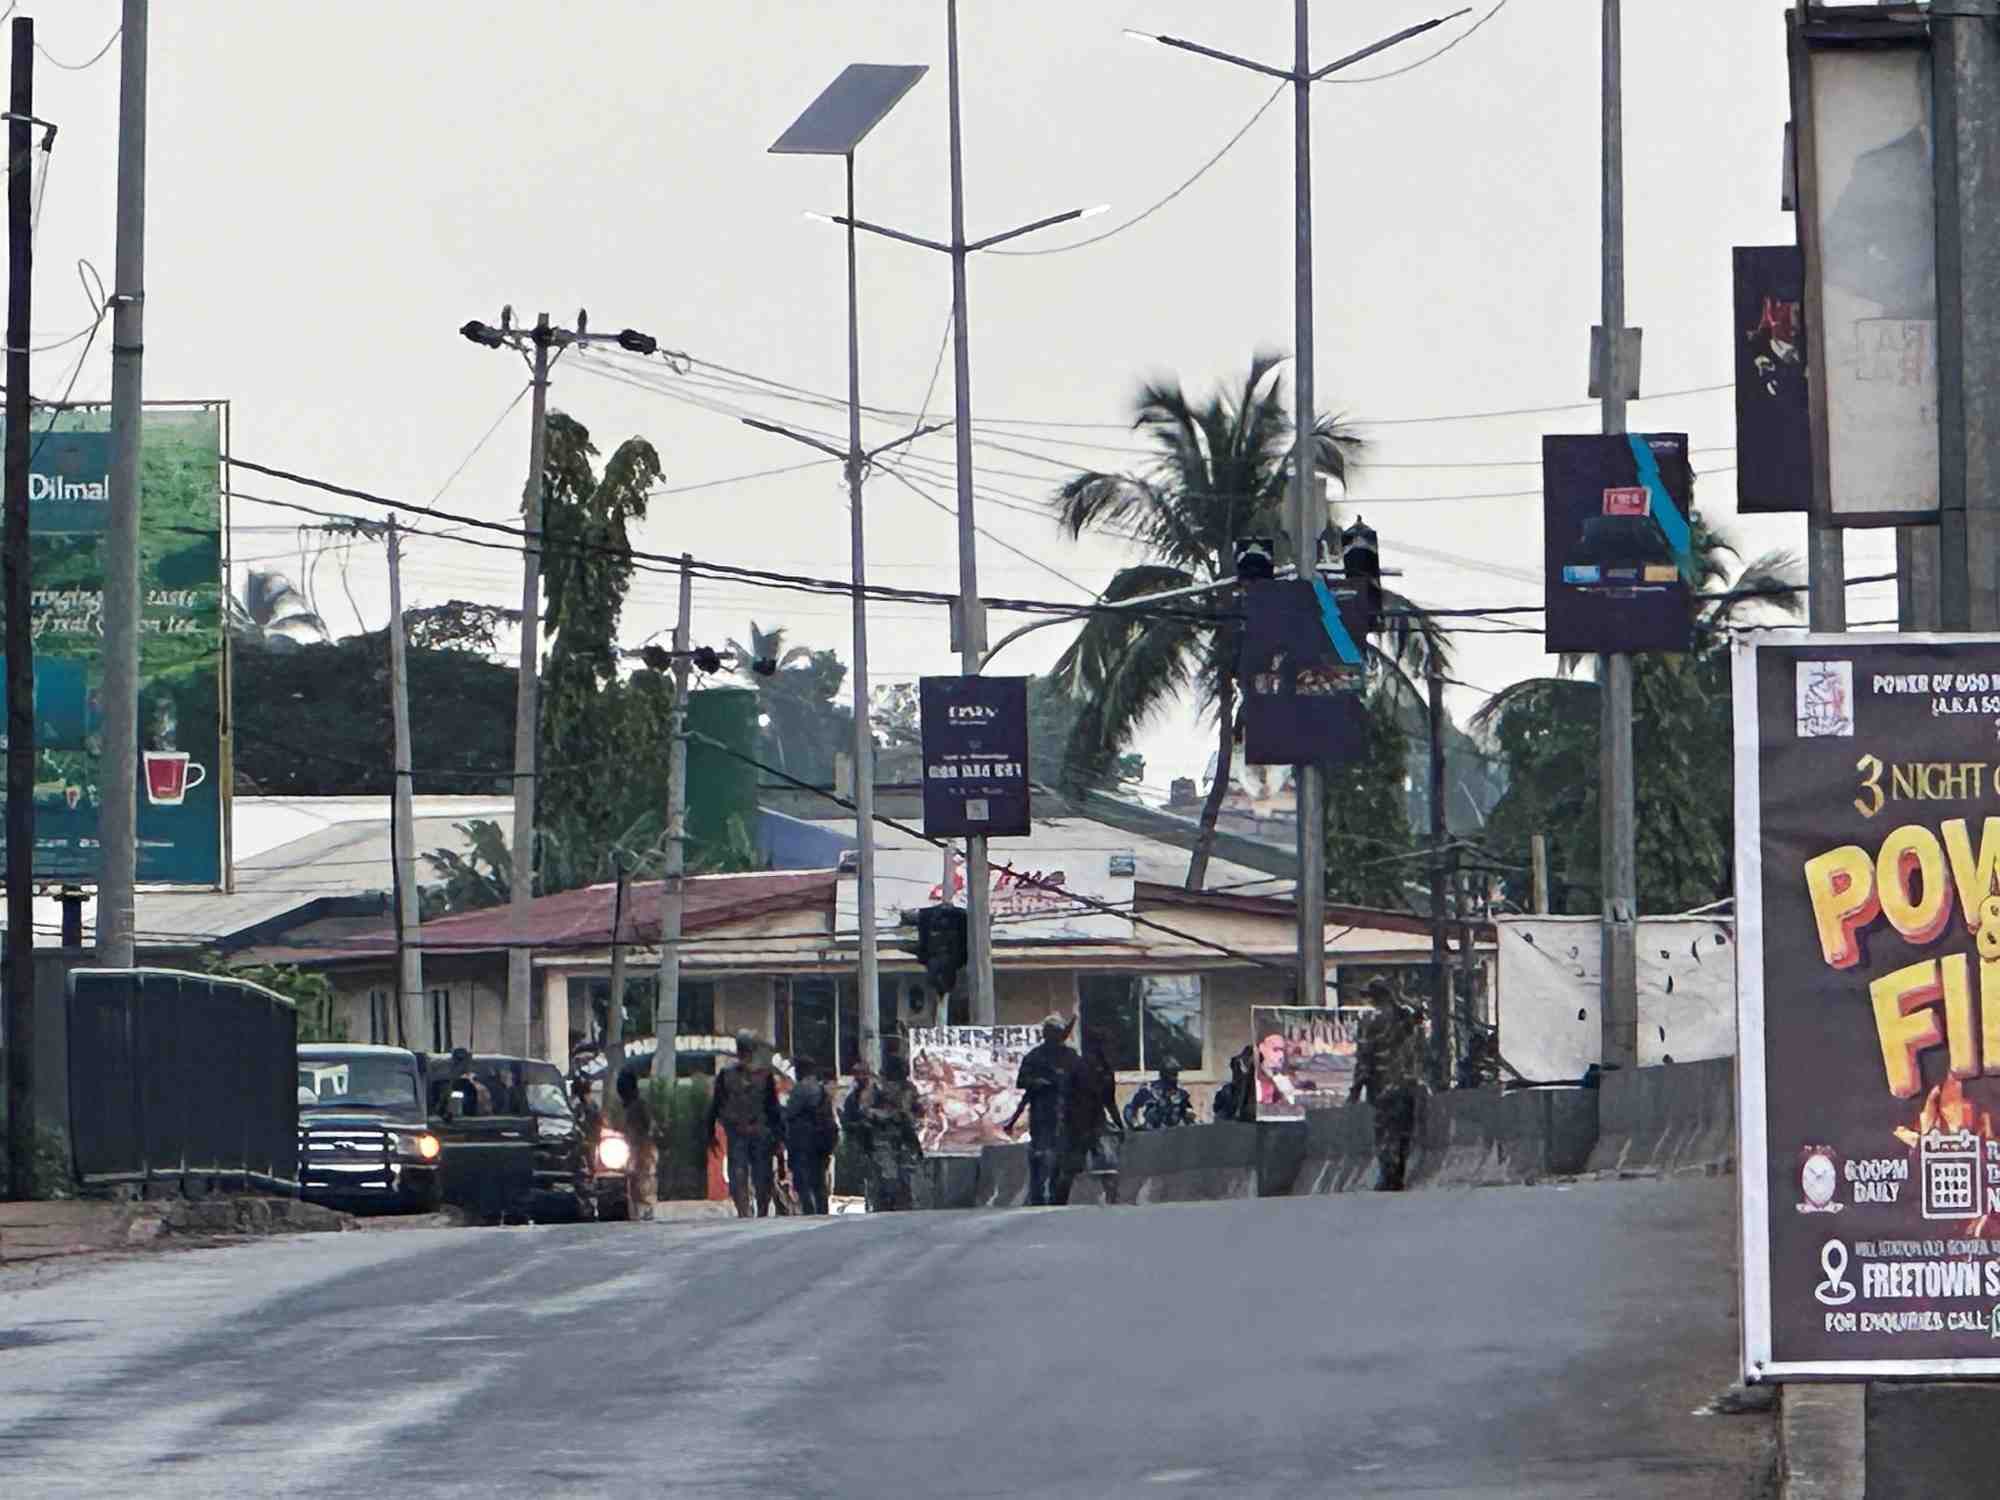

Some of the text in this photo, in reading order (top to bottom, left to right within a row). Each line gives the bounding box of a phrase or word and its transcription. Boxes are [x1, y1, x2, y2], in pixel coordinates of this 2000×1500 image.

[1932, 674, 1953, 693] OF
[1956, 673, 1989, 692] GOD
[1854, 753, 1884, 818] 3
[1892, 763, 1987, 800] NIGHT
[1862, 1261, 1980, 1298] FREETOWN
[1825, 1311, 1857, 1332] FOR
